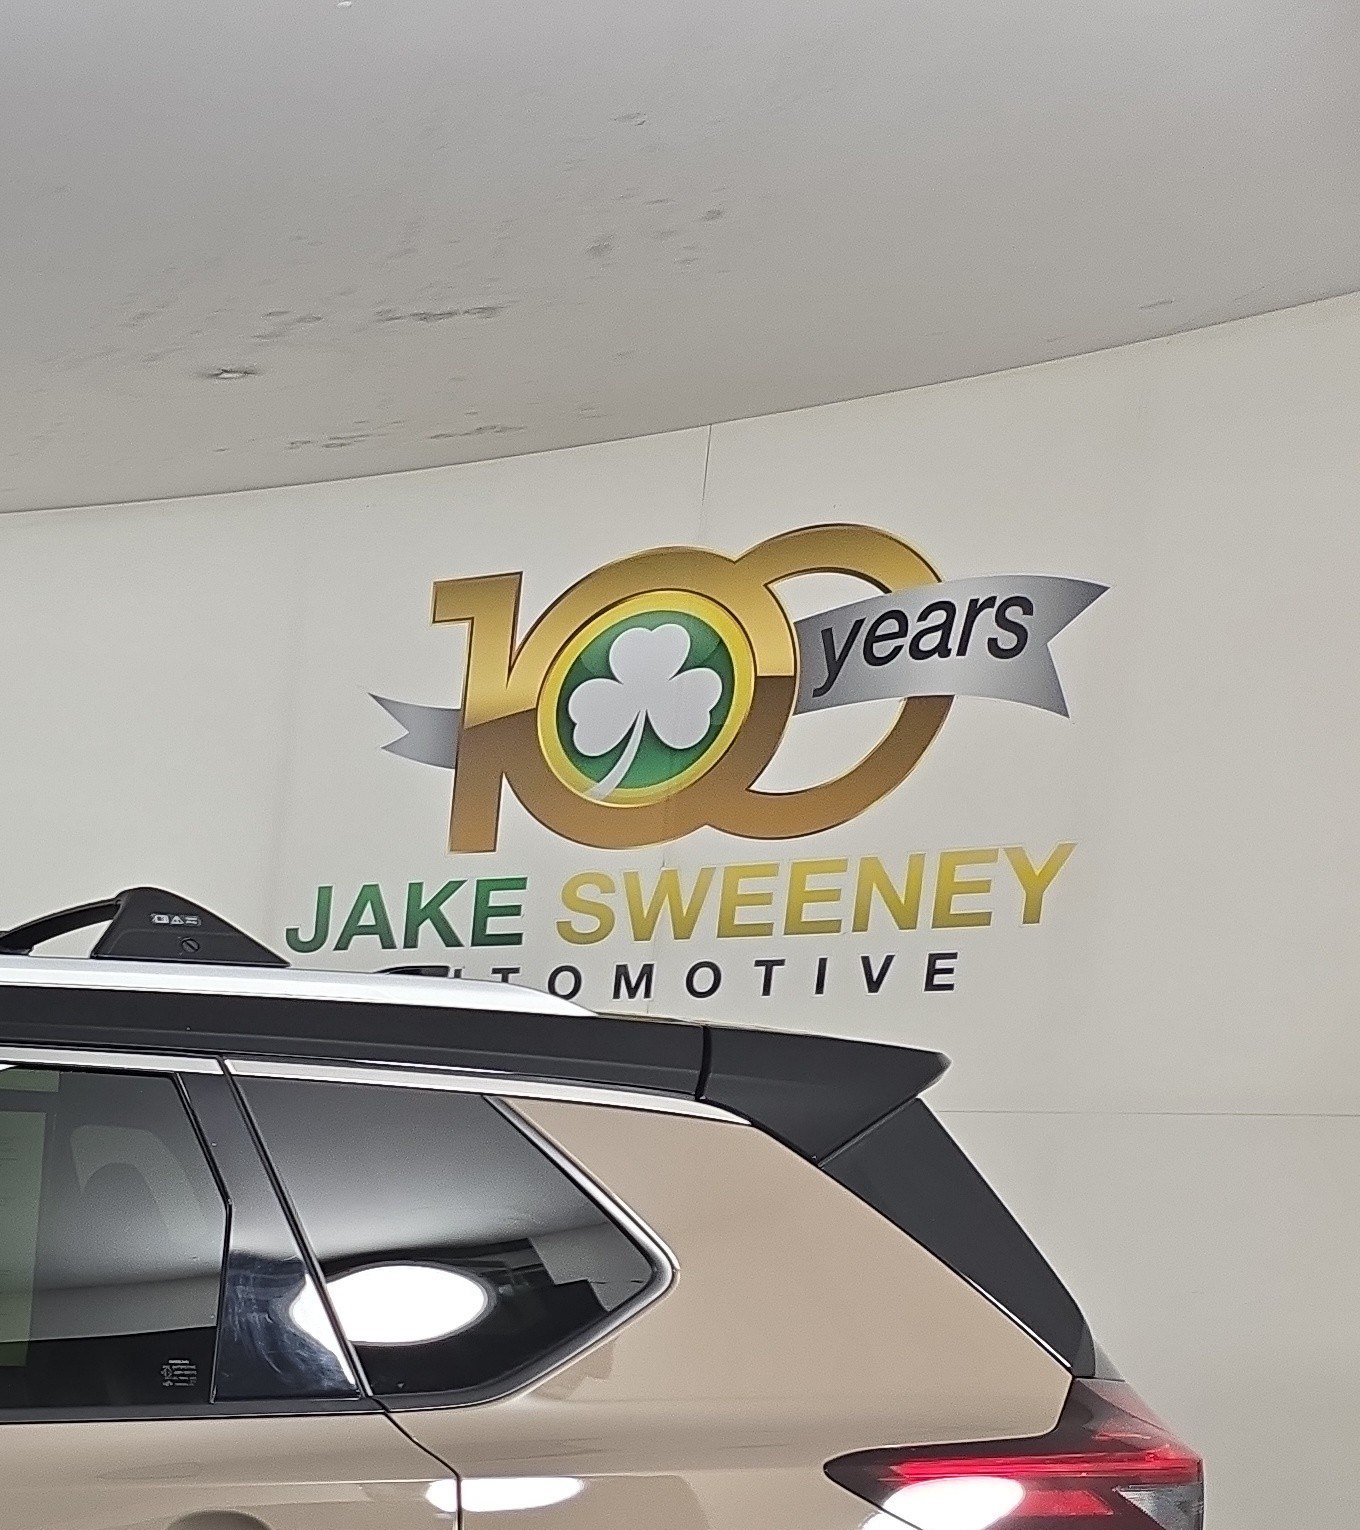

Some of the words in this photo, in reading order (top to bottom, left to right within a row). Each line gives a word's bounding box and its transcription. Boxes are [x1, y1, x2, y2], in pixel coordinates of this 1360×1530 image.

[430, 522, 957, 854] 100
[811, 591, 1035, 698] years
[285, 876, 529, 954] JAKE
[555, 841, 1079, 949] SWEENEY
[454, 951, 959, 1001] TOMOTIVE
